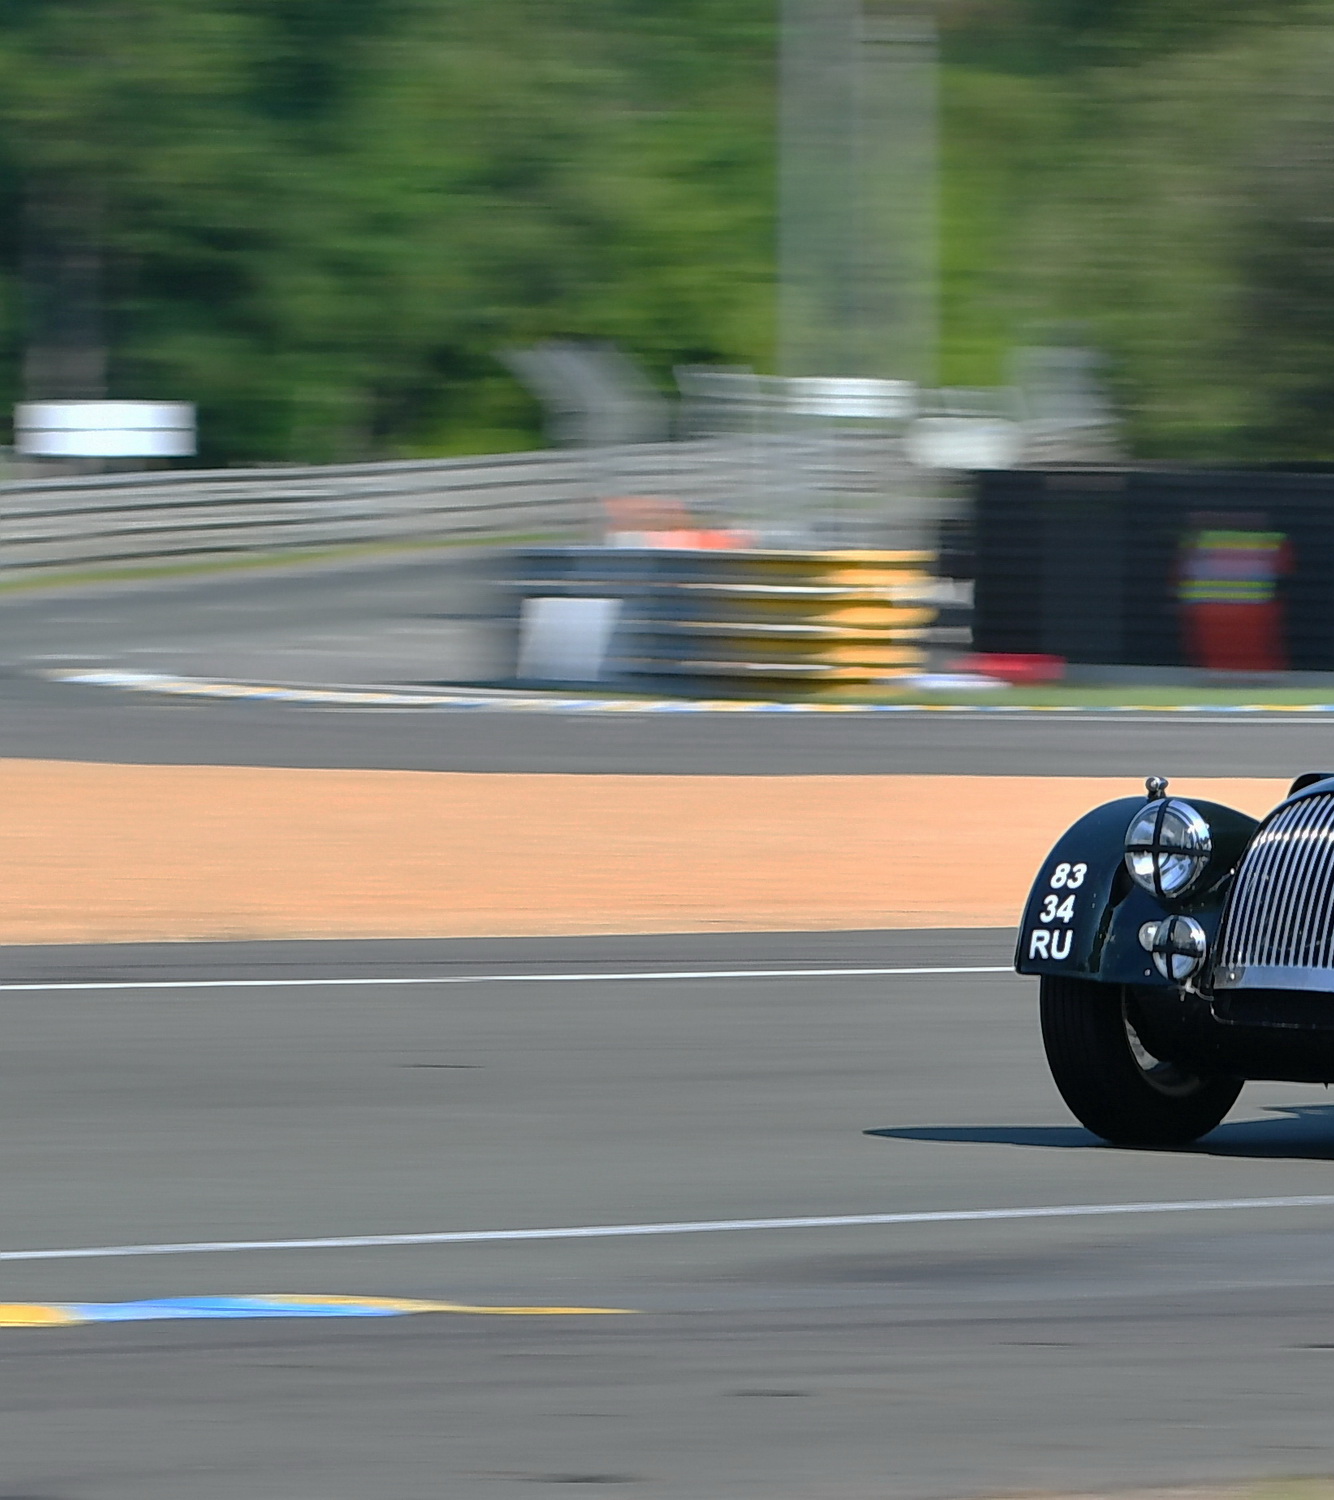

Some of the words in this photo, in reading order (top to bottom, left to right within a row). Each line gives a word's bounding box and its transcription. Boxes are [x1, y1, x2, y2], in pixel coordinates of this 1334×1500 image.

[1050, 863, 1088, 889] 83
[1040, 895, 1076, 923] 34
[1029, 929, 1073, 960] RU
